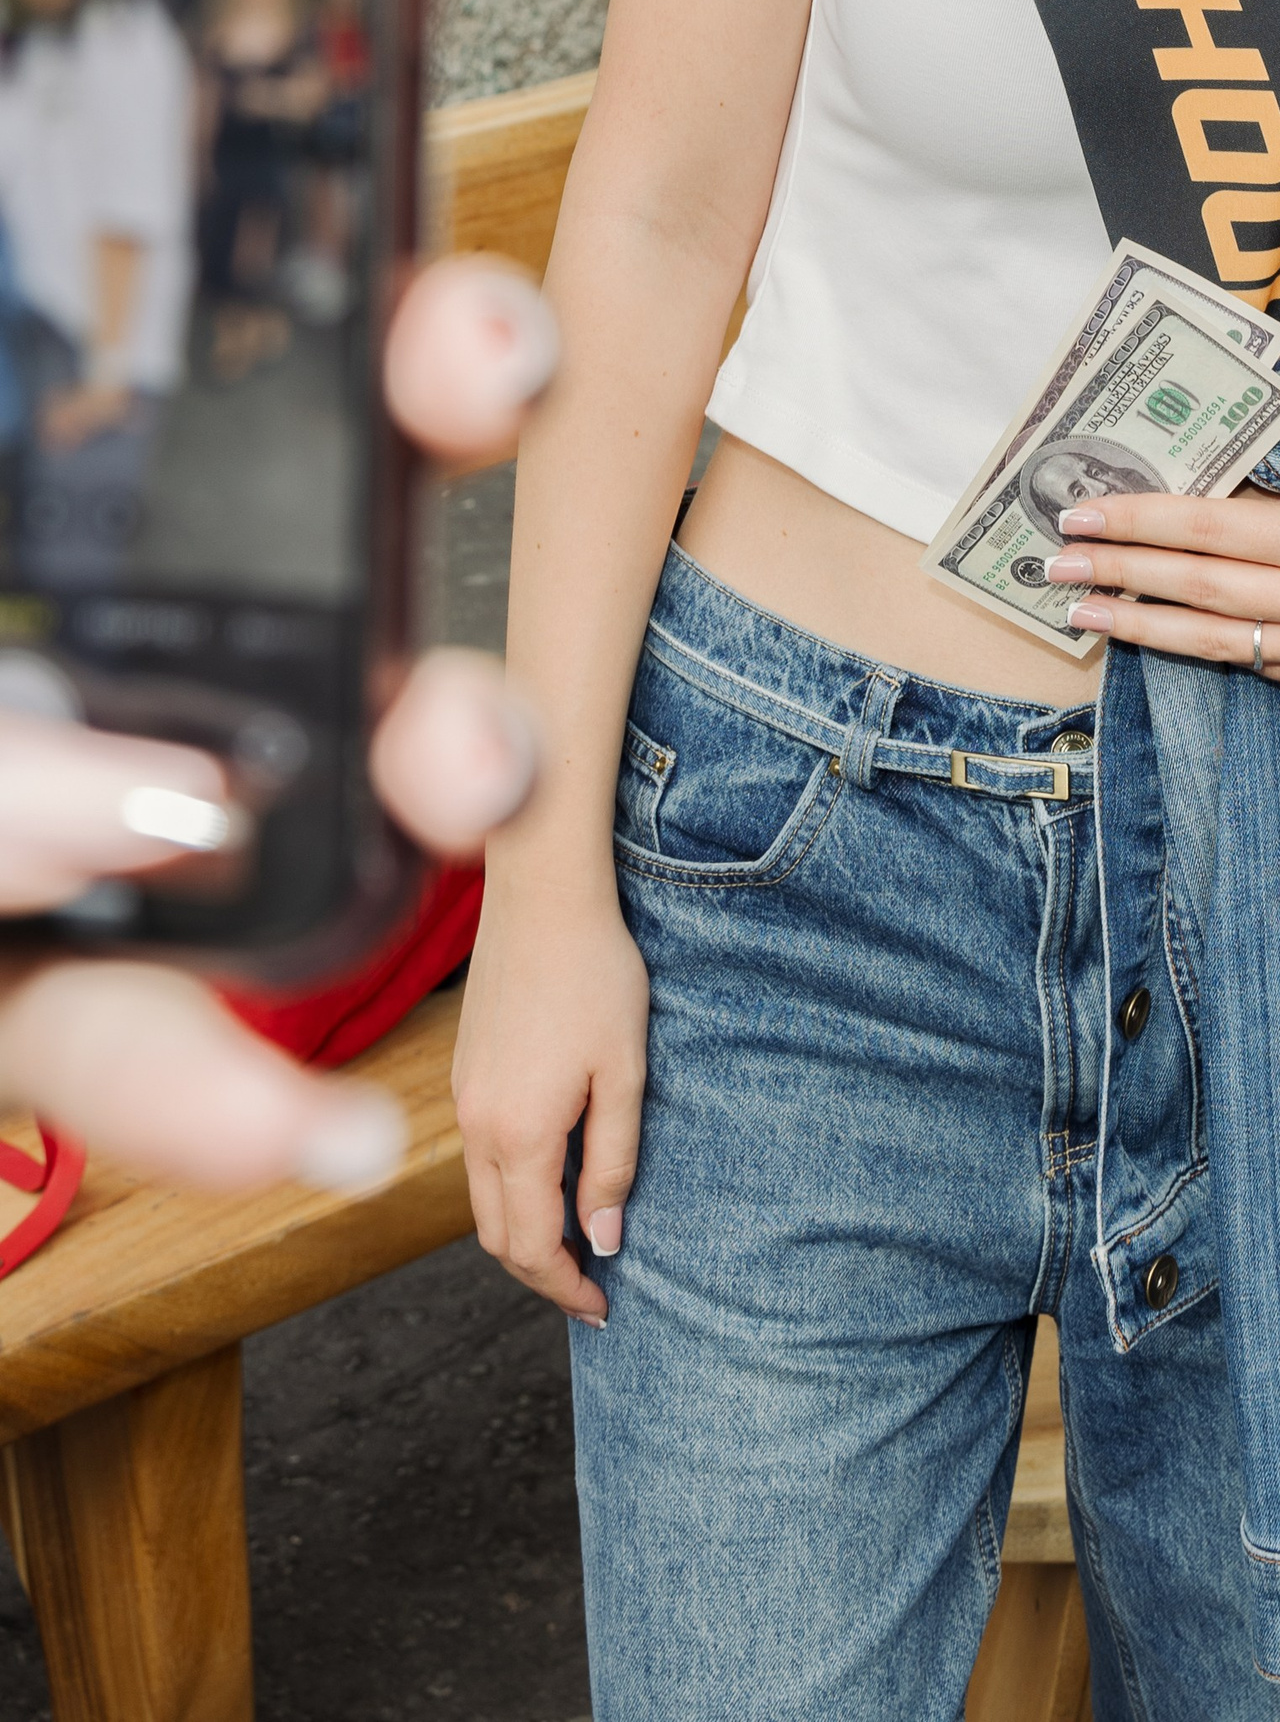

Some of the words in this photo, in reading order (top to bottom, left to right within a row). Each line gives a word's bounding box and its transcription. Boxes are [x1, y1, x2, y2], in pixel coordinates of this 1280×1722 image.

[1072, 262, 1135, 354] 100
[1098, 305, 1163, 380] 100
[1167, 443, 1182, 458] FG
[1177, 400, 1222, 446] 96003269
[1216, 382, 1266, 434] 100
[946, 498, 1007, 563] 100
[981, 569, 997, 583] FG
[991, 532, 1029, 573] 96003269
[994, 577, 1010, 591] B2
